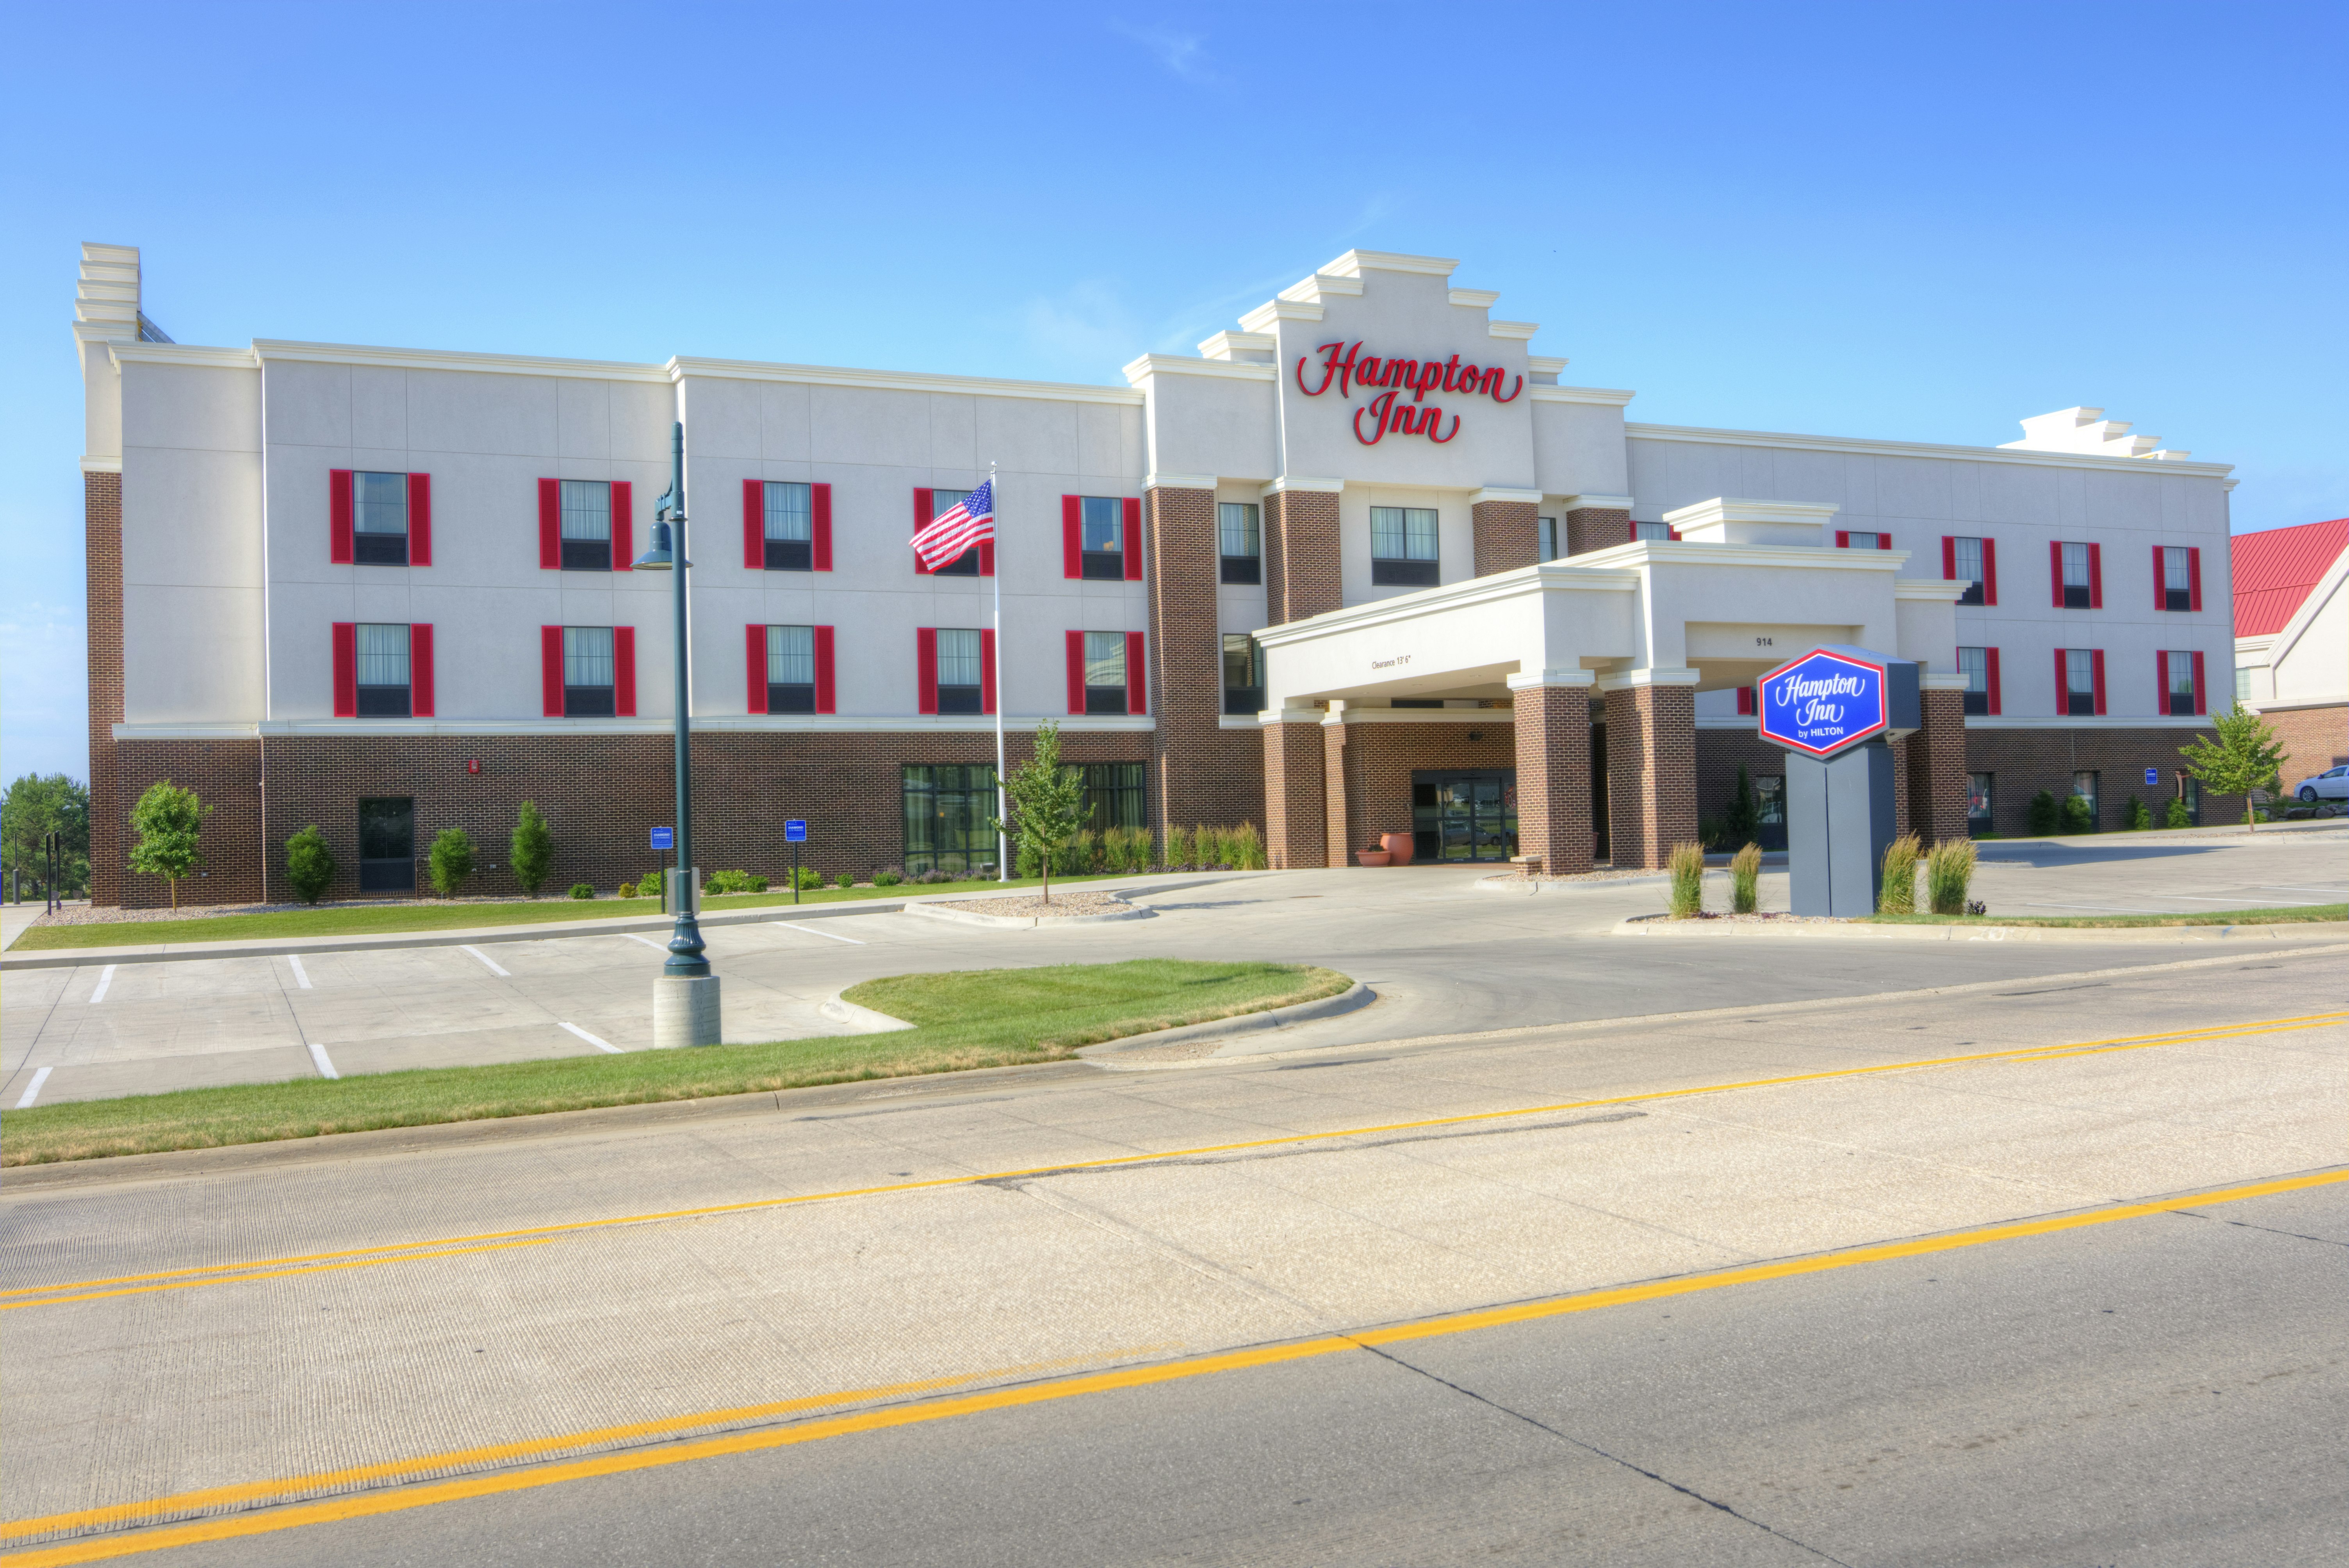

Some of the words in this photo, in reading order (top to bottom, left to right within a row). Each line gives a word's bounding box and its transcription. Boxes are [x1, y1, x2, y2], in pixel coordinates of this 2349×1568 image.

[1296, 341, 1523, 403] Hampton
[1354, 391, 1460, 445] Inn
[1757, 638, 1772, 646] 914
[1372, 659, 1395, 670] Clearance
[1776, 673, 1865, 706] Hampton
[1796, 698, 1844, 726] Inn
[1798, 730, 1808, 739] by
[1811, 727, 1844, 736] HILTON
